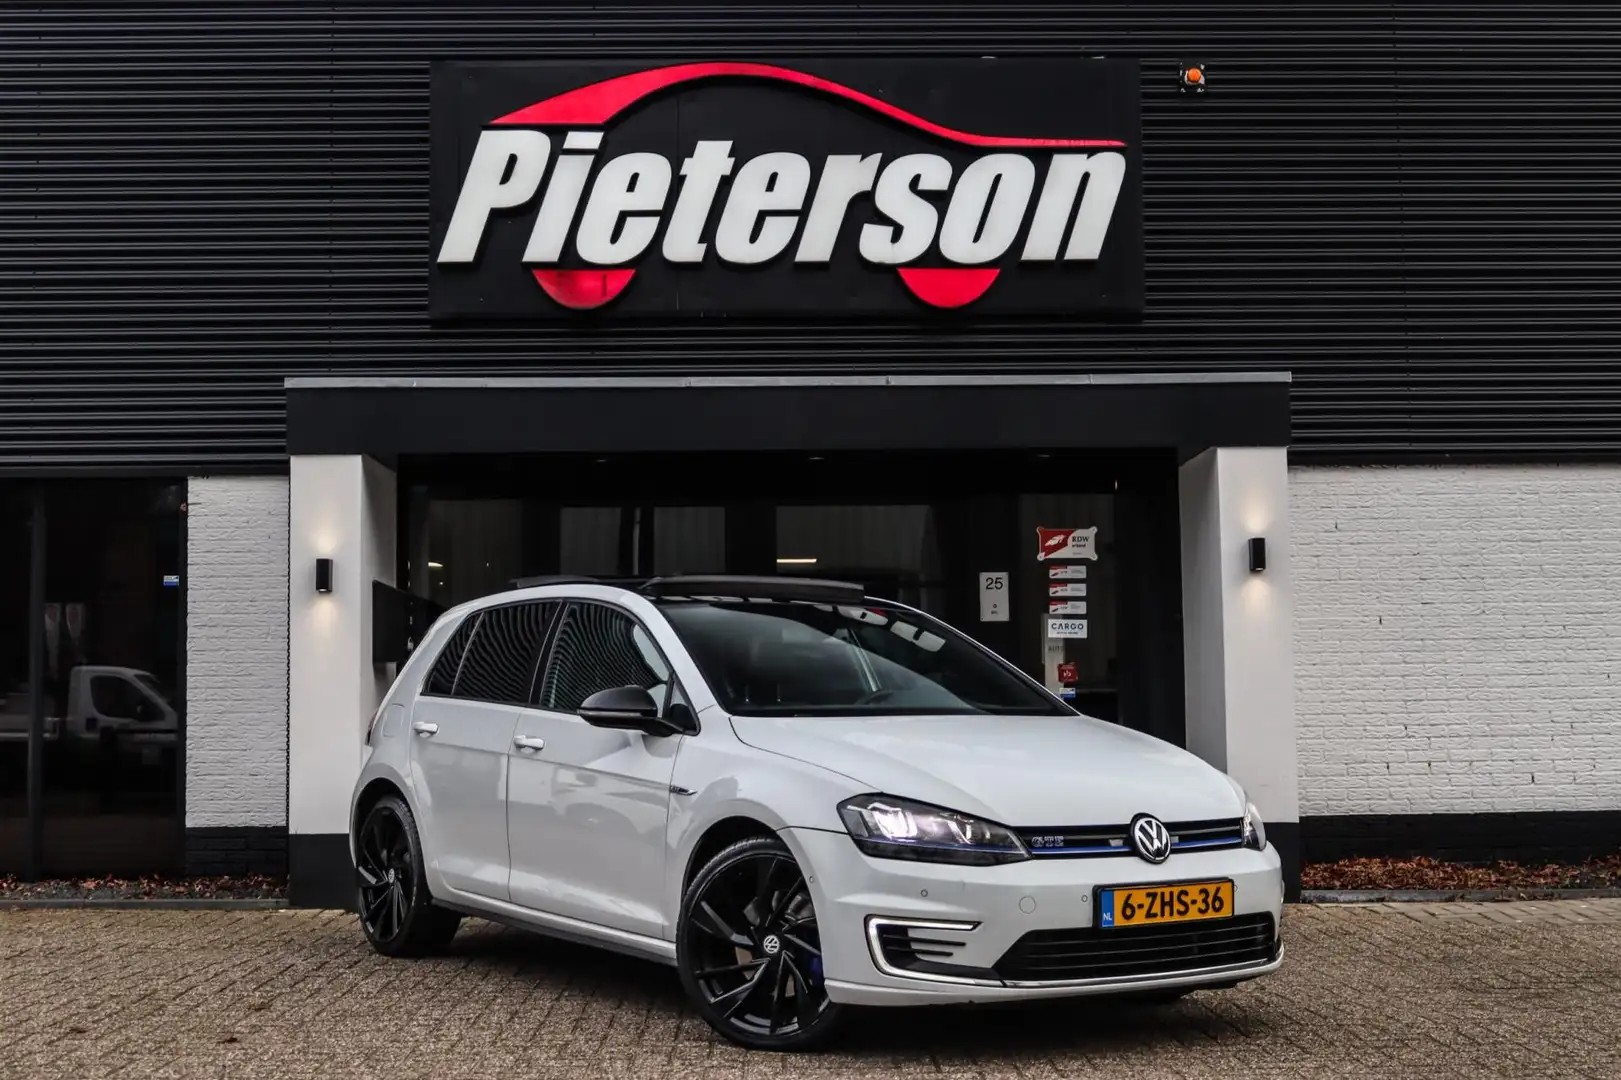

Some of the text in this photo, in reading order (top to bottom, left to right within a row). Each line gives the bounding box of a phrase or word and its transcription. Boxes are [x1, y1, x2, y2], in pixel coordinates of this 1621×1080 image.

[436, 130, 1127, 264] Pieterson
[985, 577, 1004, 590] 25
[1121, 887, 1224, 920] 6-ZHS-36
[1103, 912, 1112, 921] NL
